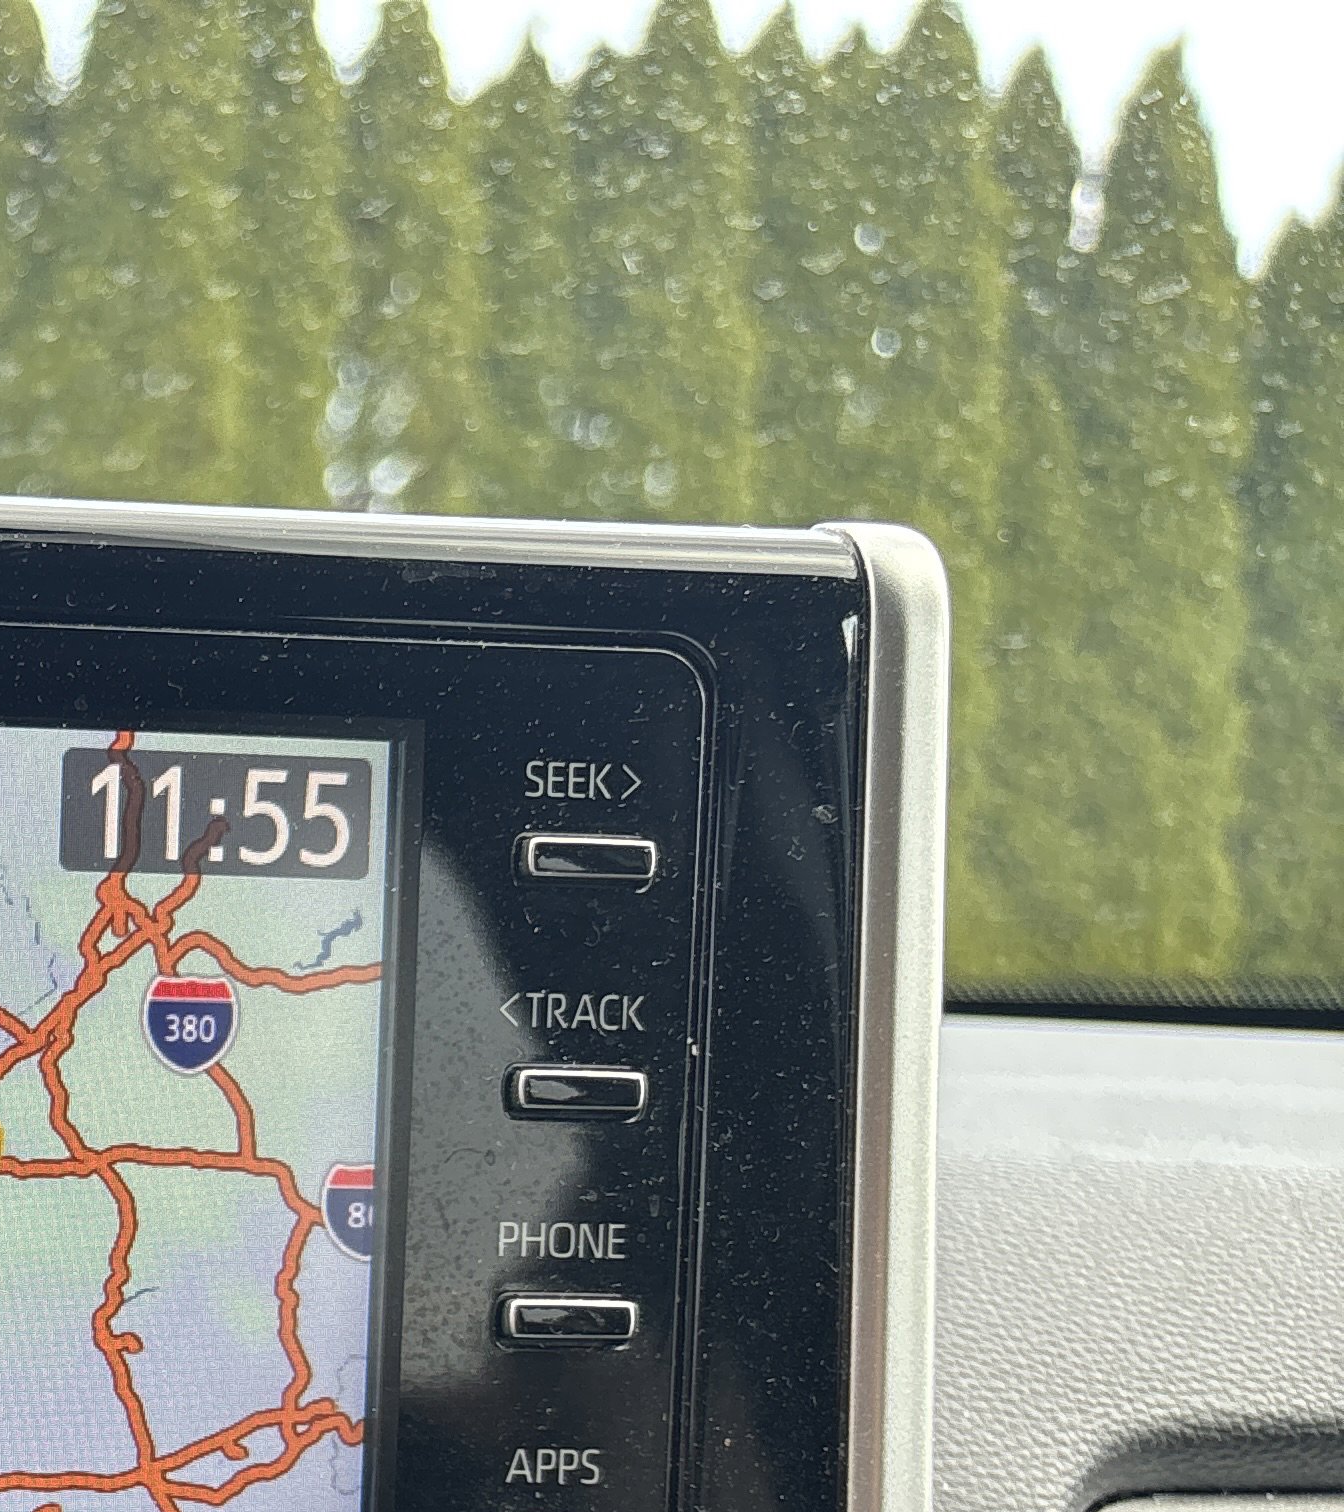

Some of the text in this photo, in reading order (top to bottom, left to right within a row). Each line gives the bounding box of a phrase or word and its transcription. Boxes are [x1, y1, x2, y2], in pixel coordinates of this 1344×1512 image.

[525, 761, 611, 799] SEEK
[91, 764, 350, 867] 11:55
[166, 1014, 215, 1042] 380
[526, 990, 644, 1030] TRACK
[348, 1202, 373, 1228] 8
[498, 1222, 626, 1259] PHONE
[506, 1449, 600, 1484] APPS
